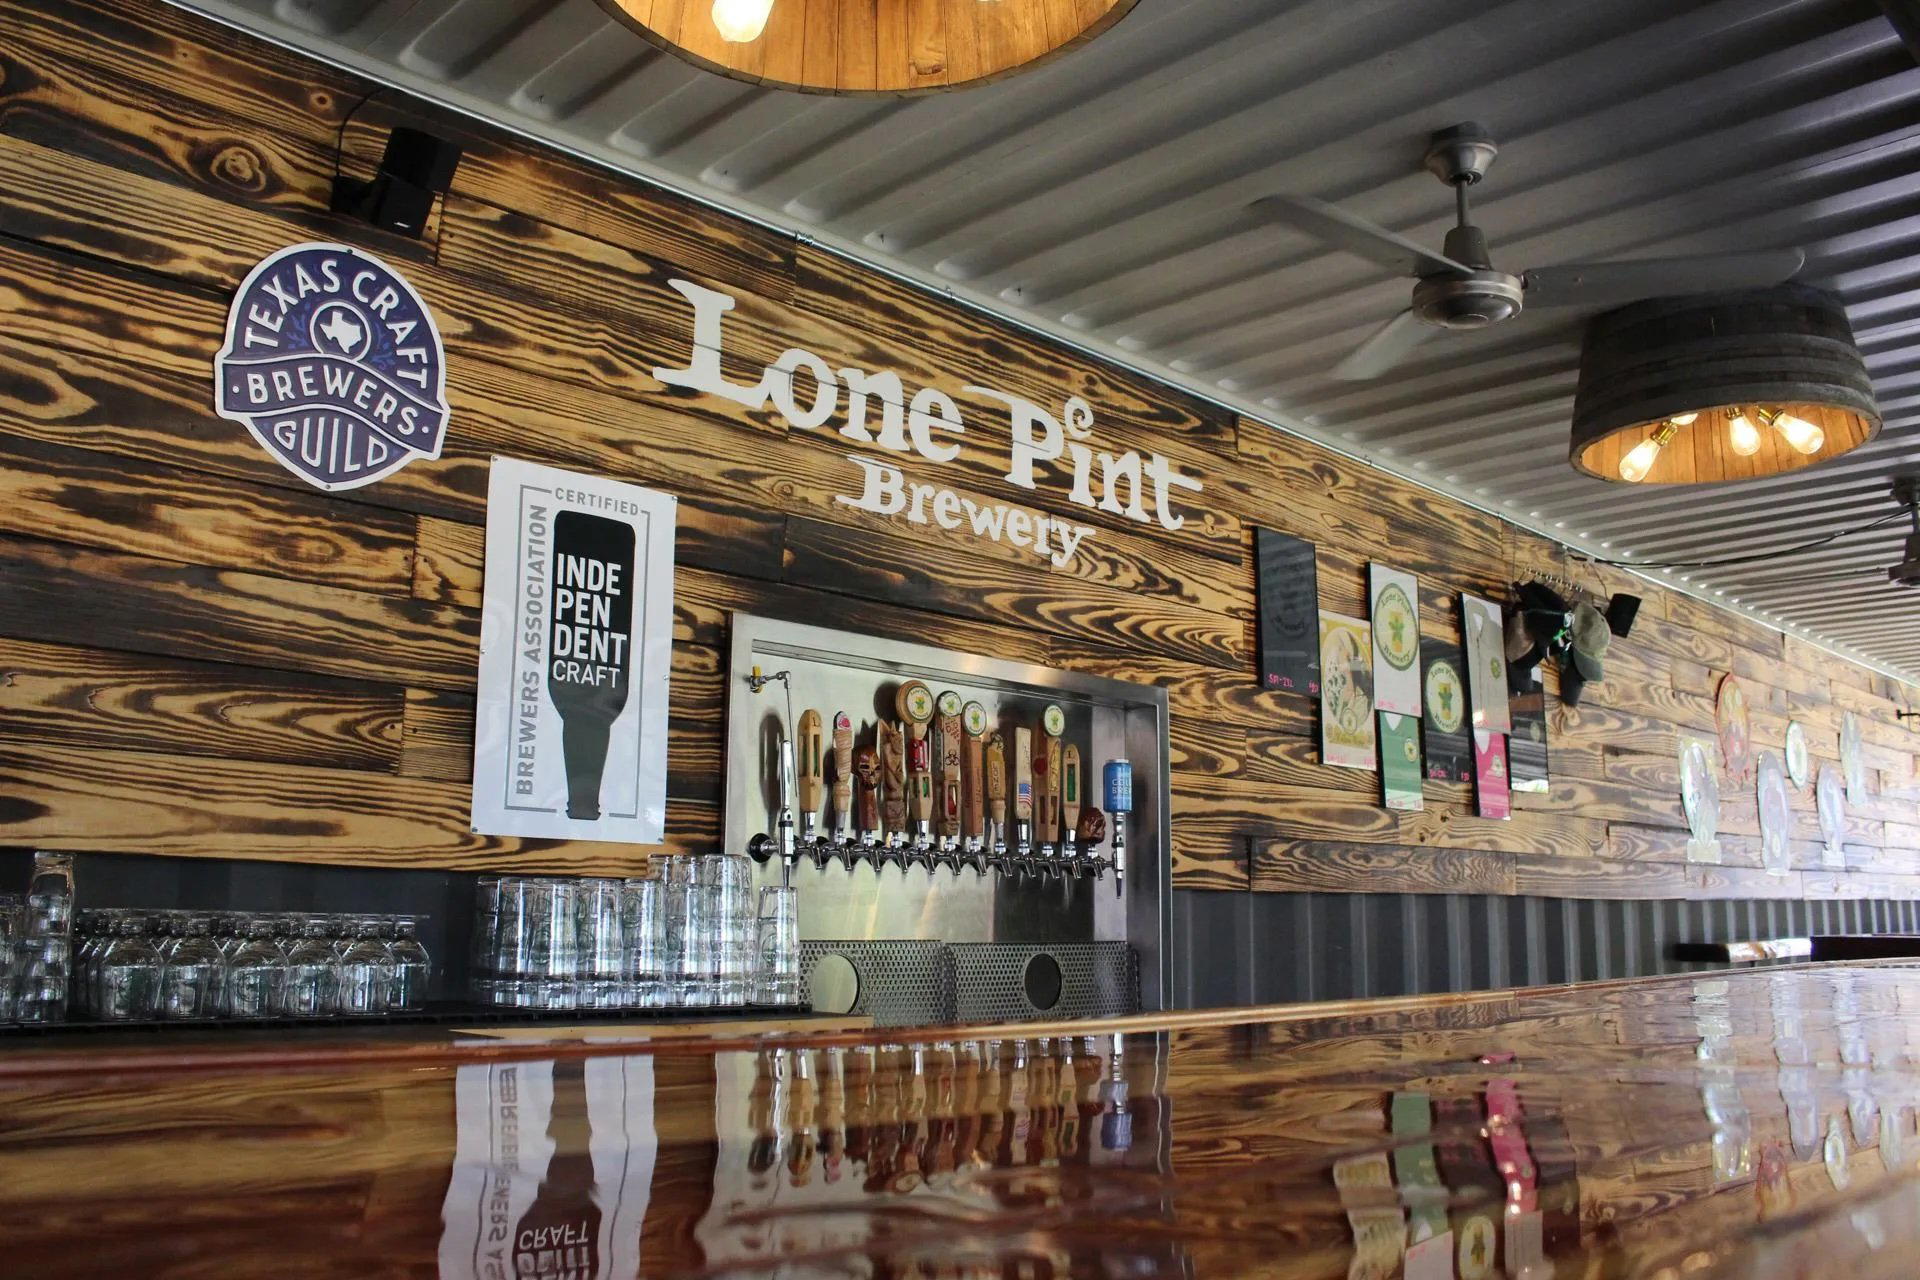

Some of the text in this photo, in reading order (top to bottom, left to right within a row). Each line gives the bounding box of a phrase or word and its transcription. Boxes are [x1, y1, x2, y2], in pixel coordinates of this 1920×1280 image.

[244, 260, 428, 389] TEXAS CRAFT
[247, 364, 418, 435] BREWERS
[652, 278, 1203, 530] Lone Pint
[273, 416, 388, 473] GUILD
[555, 487, 639, 516] CERTIFIED
[835, 454, 1095, 568] Brewery
[556, 552, 622, 596] INDE
[555, 587, 611, 628] PEN
[515, 505, 548, 795] BREWERS ASSOCIATION
[551, 659, 621, 689] CRAFT
[553, 628, 628, 665] DENT
